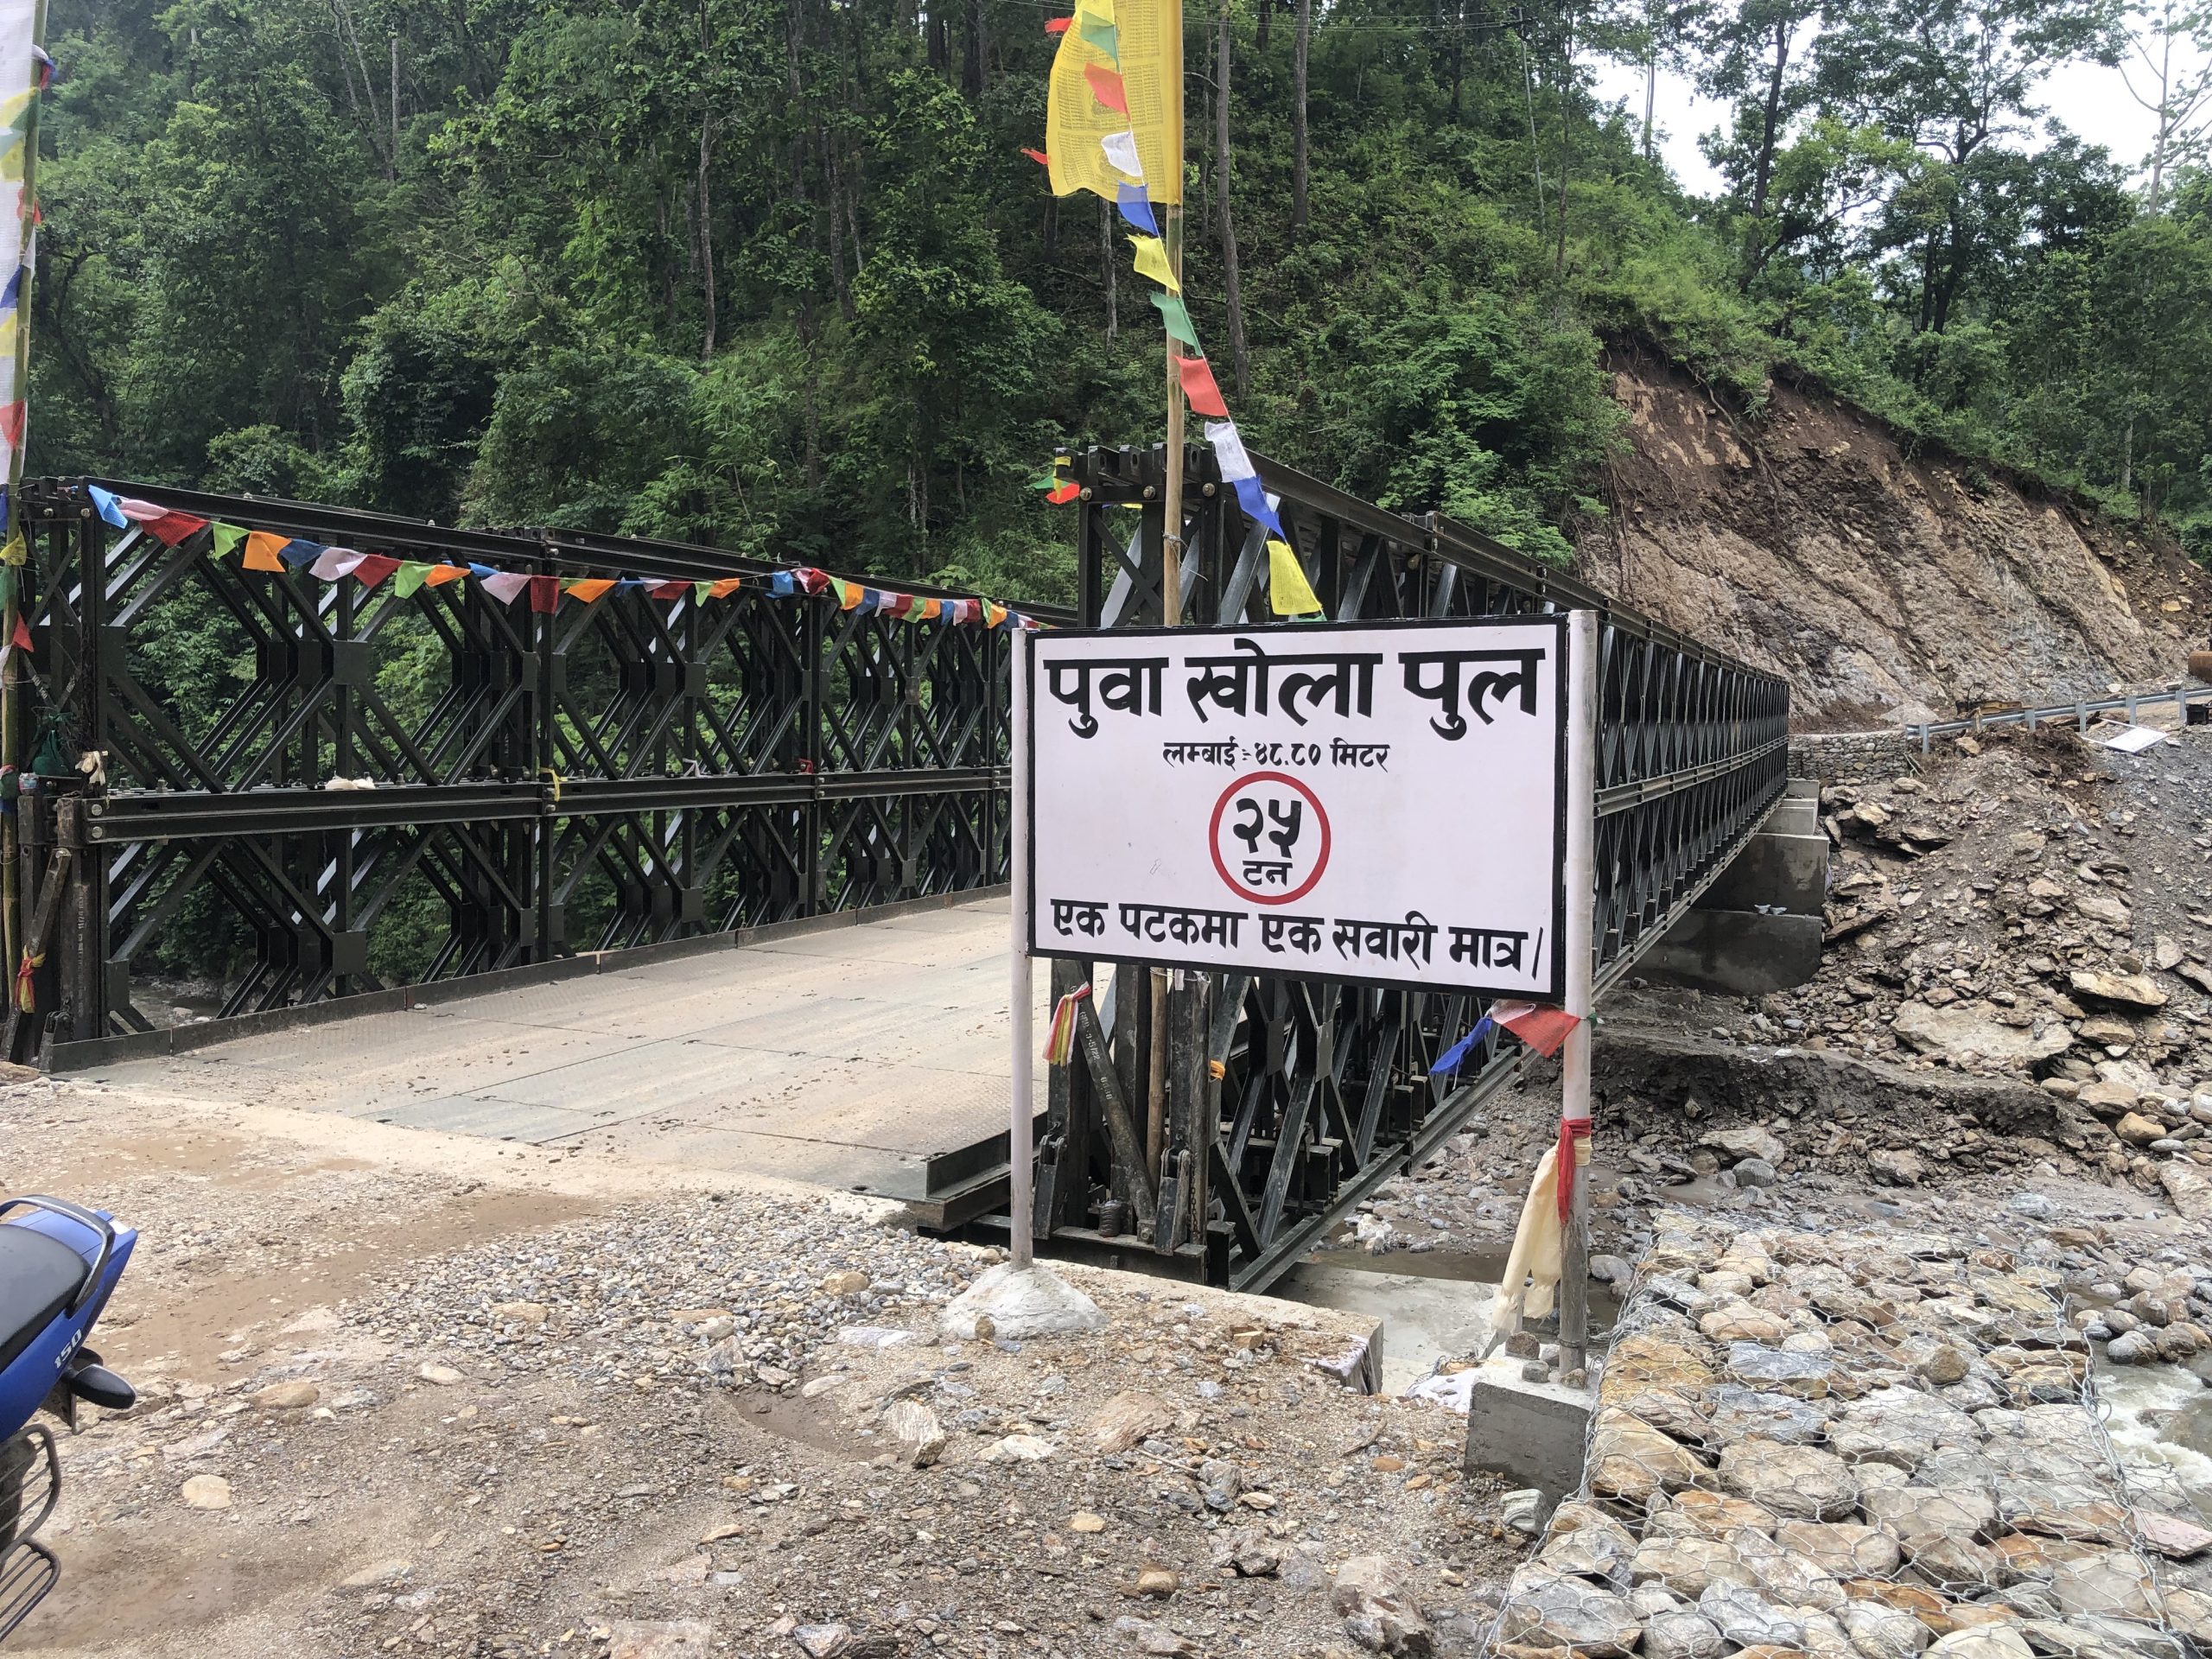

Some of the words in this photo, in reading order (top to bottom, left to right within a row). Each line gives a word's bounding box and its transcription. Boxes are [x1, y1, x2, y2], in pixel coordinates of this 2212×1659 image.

[1042, 657, 1170, 740] पुवा
[1184, 638, 1383, 727] खोला
[1397, 647, 1546, 741] पुल
[1329, 737, 1391, 772] मिटर
[1232, 798, 1302, 859] २५
[1242, 860, 1294, 887] टन
[1050, 898, 1109, 938] एक
[1118, 902, 1249, 949] पटकमा
[1257, 913, 1325, 956] एक
[1332, 910, 1439, 970] सवारी
[54, 1328, 82, 1370] 150
